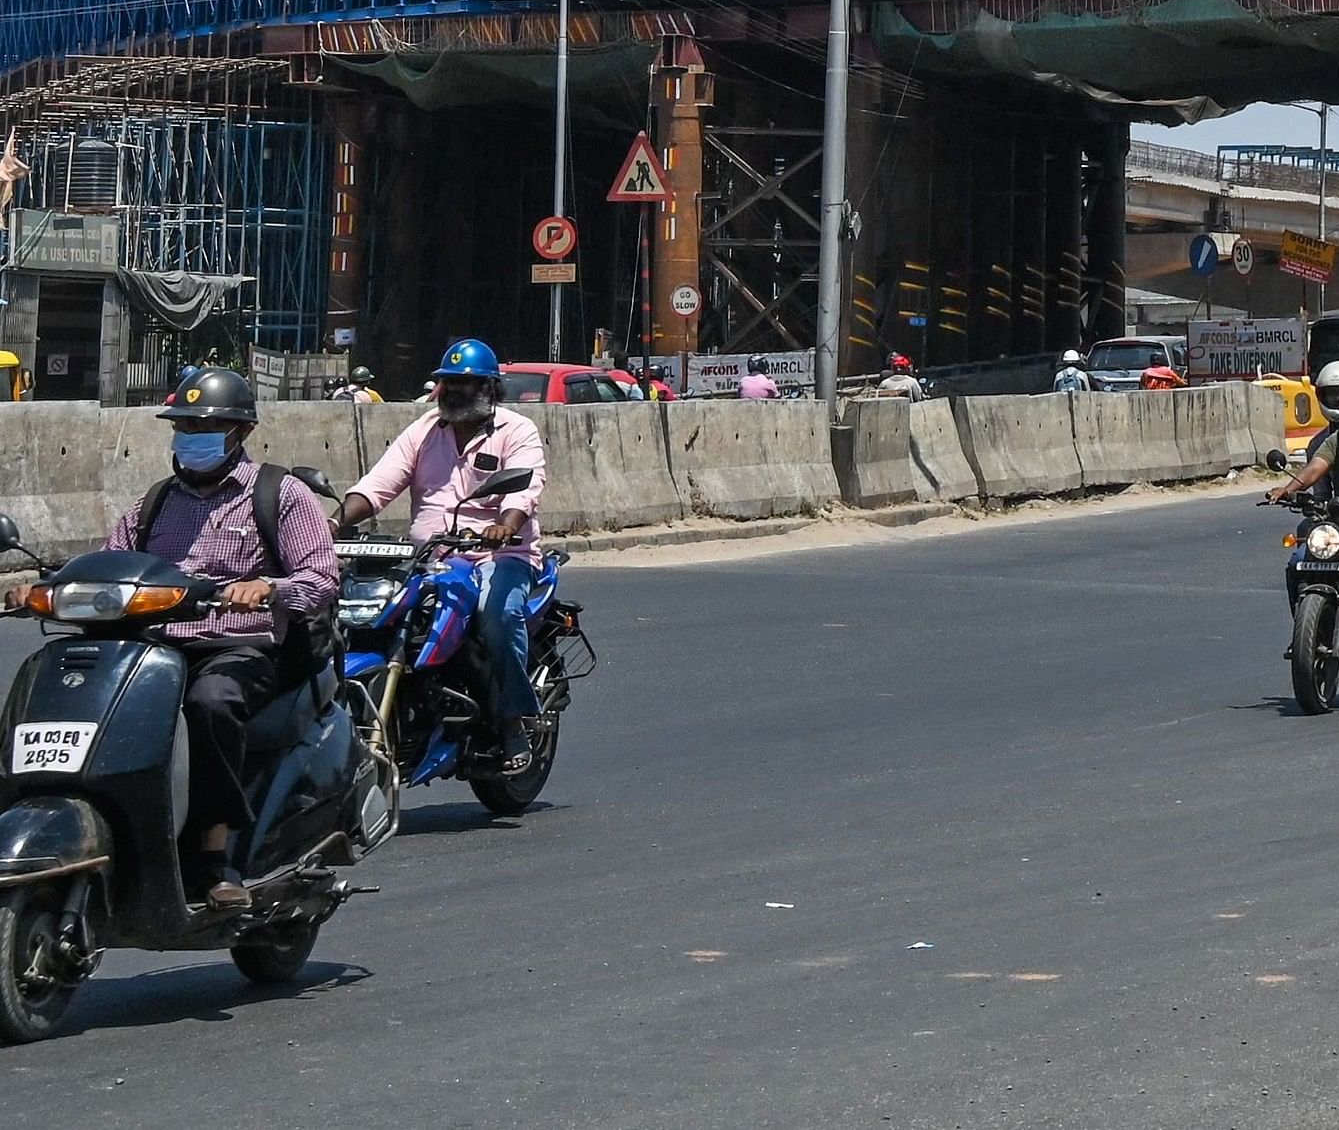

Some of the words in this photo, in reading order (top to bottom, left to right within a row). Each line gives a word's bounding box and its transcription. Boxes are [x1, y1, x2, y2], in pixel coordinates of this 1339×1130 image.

[41, 247, 48, 261] &
[50, 248, 67, 261] USE
[70, 248, 101, 262] TOILET
[1236, 245, 1250, 263] 30
[676, 302, 696, 310] SLOW
[1256, 330, 1297, 344] BMRCL
[1209, 351, 1232, 375] TAKE
[1234, 350, 1282, 374] DIVERSION
[700, 364, 739, 377] AFCONS
[24, 731, 40, 746] KA
[44, 731, 61, 744] 03
[63, 731, 80, 747] EQ
[24, 749, 70, 765] 2835
